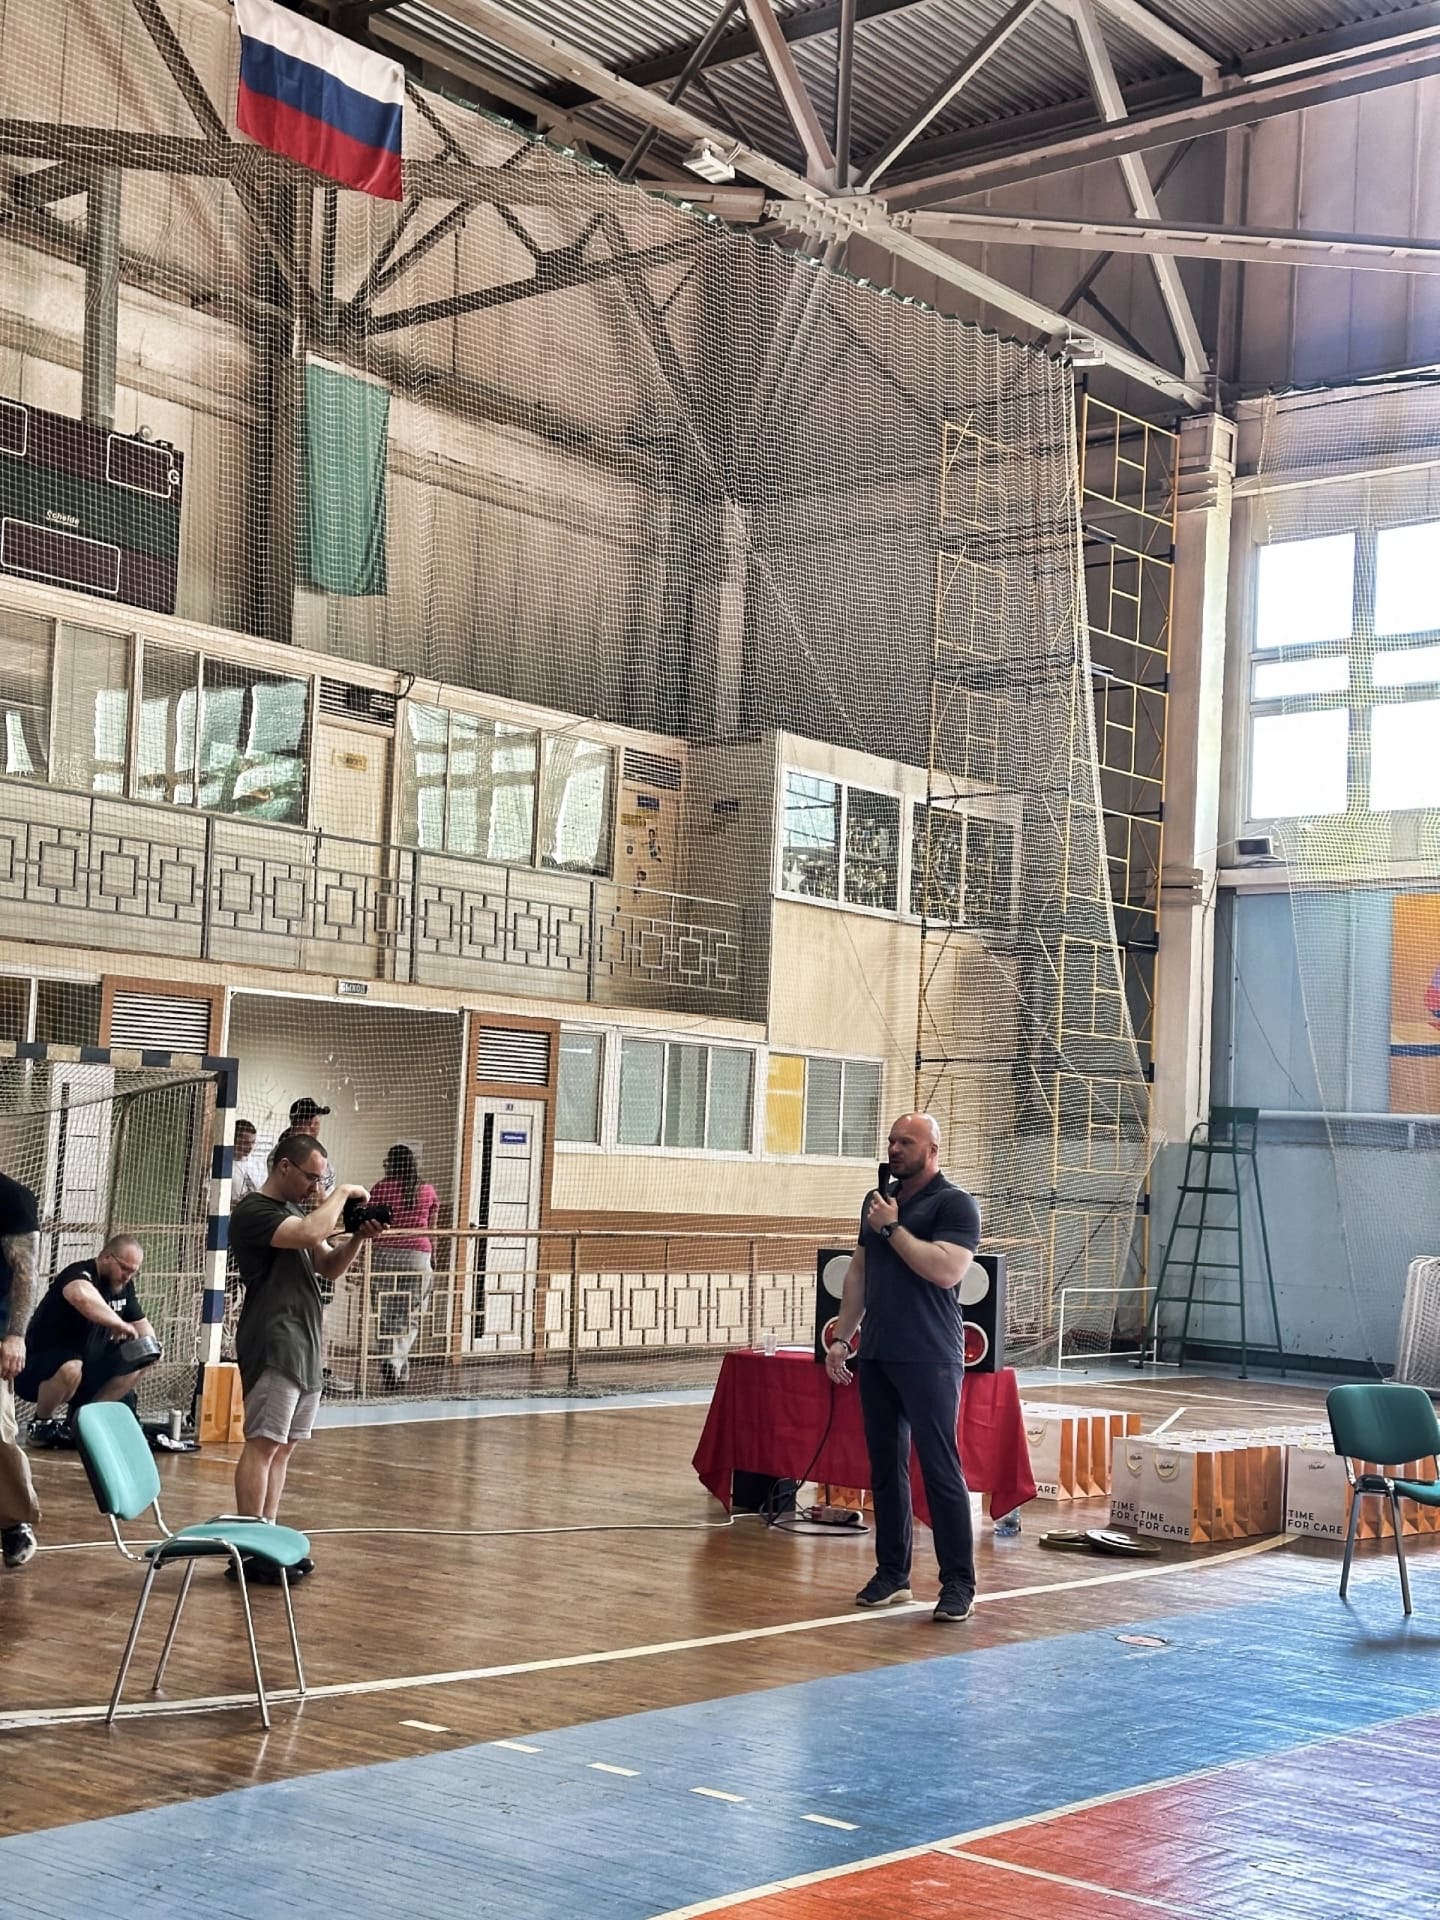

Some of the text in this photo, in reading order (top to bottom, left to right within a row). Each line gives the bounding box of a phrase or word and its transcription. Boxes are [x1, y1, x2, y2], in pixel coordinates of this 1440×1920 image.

[168, 469, 180, 485] G
[1037, 1485, 1057, 1495] ARE
[1111, 1500, 1135, 1511] TIME
[1111, 1510, 1130, 1520] FOR
[1140, 1510, 1165, 1522] TIME
[1288, 1509, 1315, 1521] TIME
[1139, 1520, 1190, 1536] FOR CARE
[1287, 1519, 1343, 1534] FOR CARE
